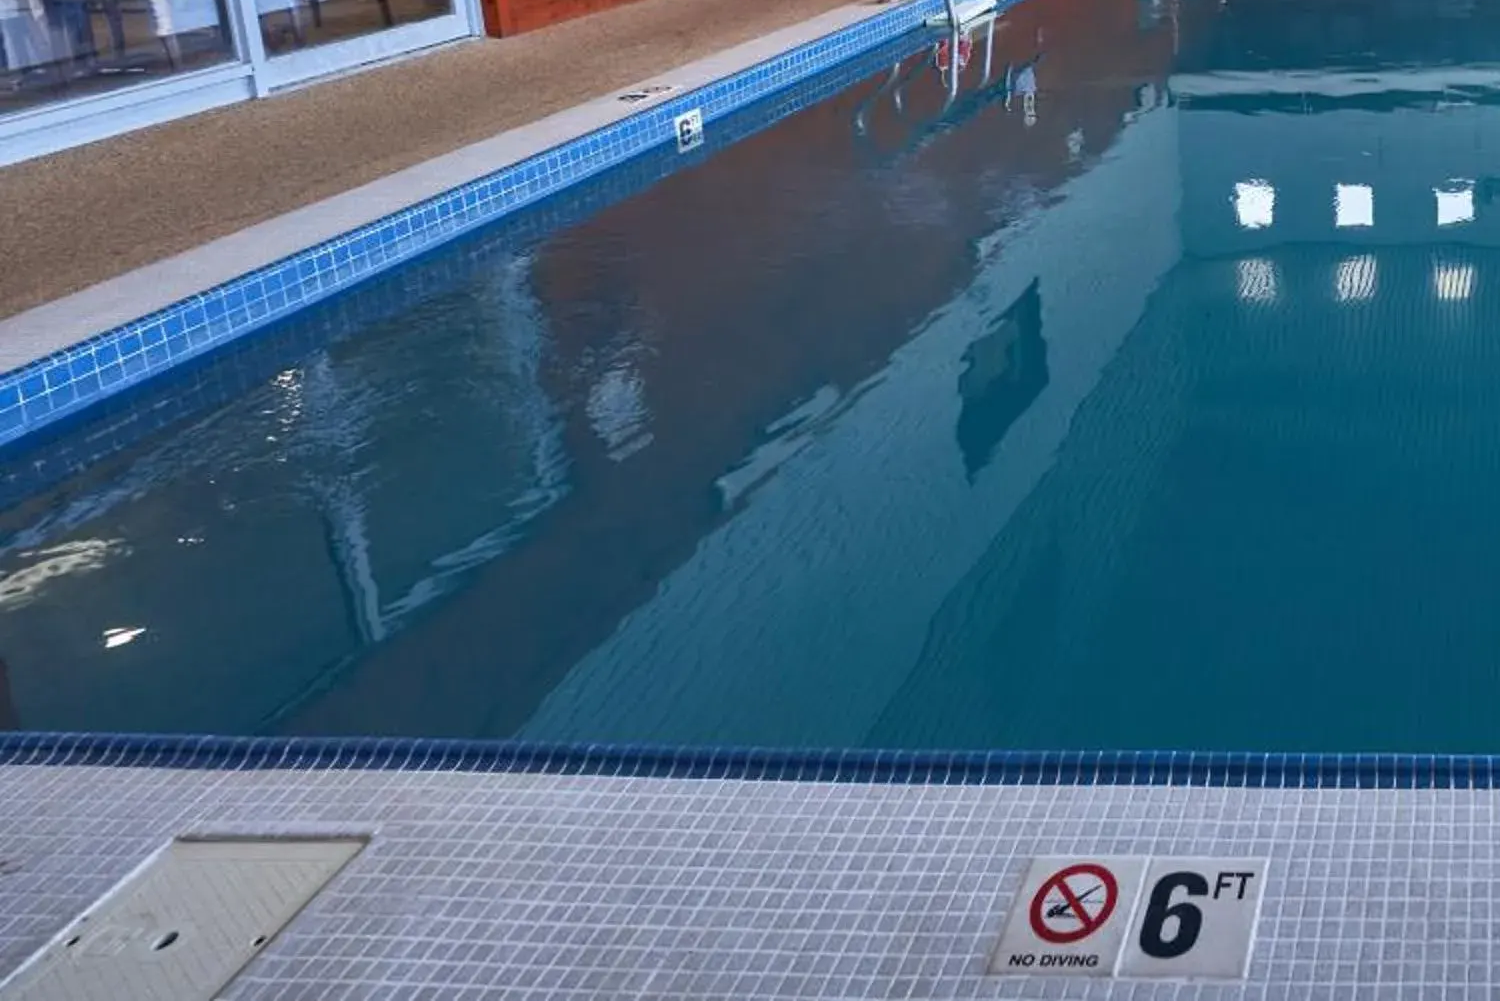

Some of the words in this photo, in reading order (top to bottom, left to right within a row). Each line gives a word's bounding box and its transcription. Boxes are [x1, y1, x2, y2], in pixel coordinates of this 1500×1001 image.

[1138, 870, 1209, 959] 6
[1213, 872, 1255, 900] FT
[1008, 954, 1035, 967] NO
[1039, 954, 1099, 967] DIVING
